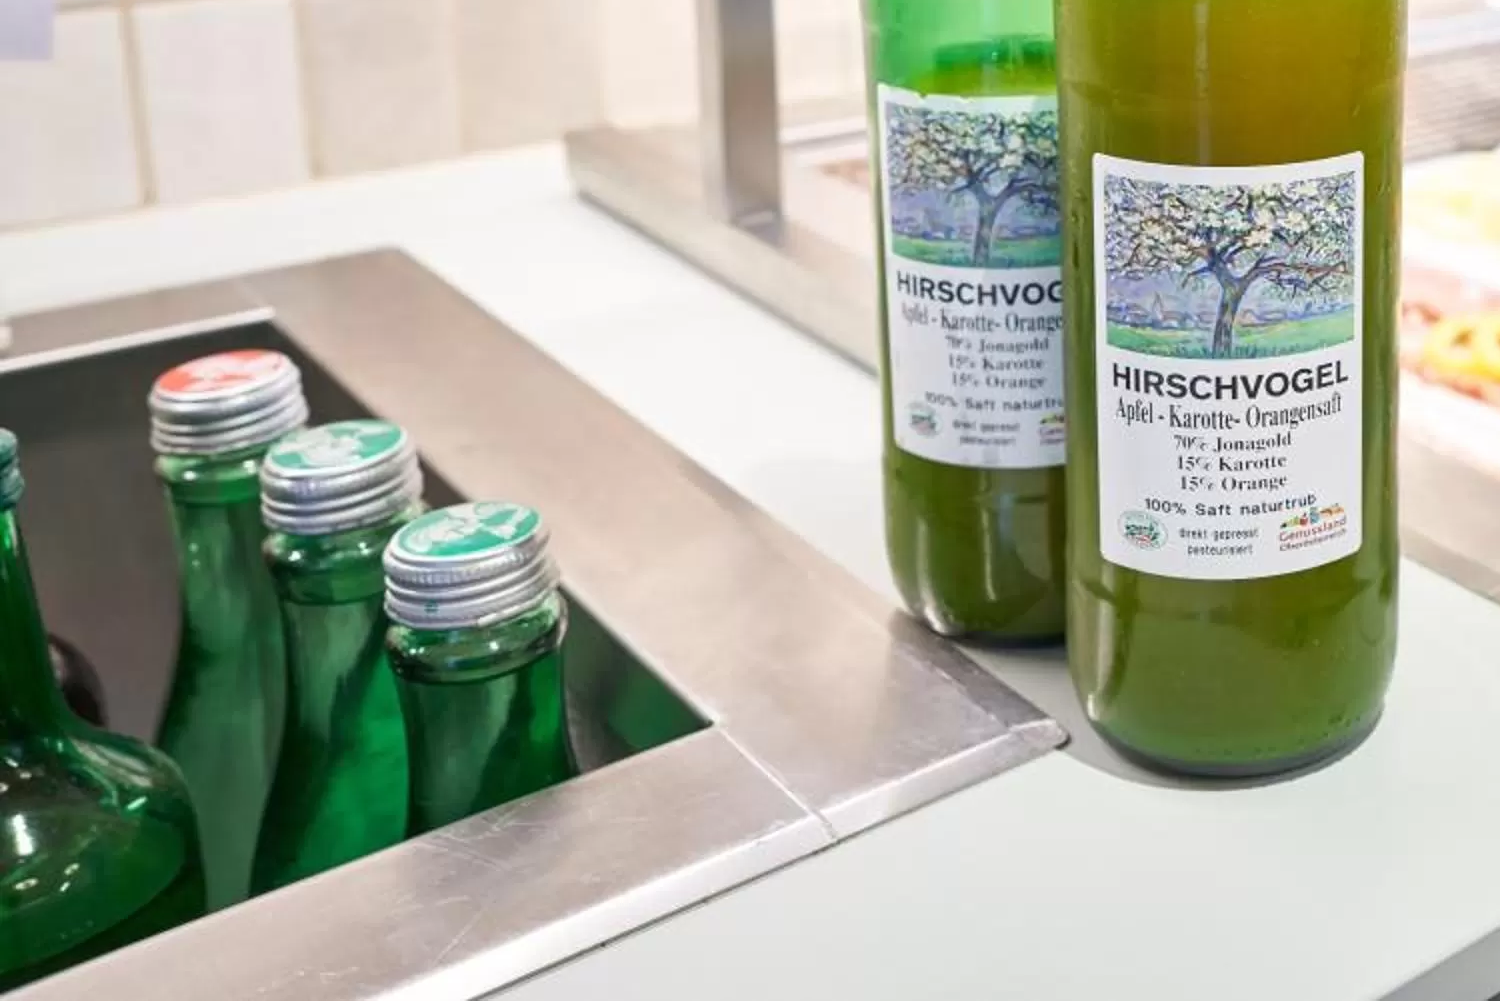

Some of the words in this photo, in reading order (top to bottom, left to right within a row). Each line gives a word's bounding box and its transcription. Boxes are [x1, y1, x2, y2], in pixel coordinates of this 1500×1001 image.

[978, 337, 1049, 354] Jonagold
[982, 357, 1045, 371] Karotte
[985, 376, 1047, 389] Orange
[1112, 360, 1349, 400] HIRSCHVOGEL
[1115, 396, 1154, 427] Apfel
[1246, 391, 1342, 429] Orangensaft
[1174, 434, 1209, 452] 70%
[1213, 431, 1292, 453] Jonagold
[1178, 455, 1212, 471] 15%
[1219, 455, 1288, 471] Karotte
[1181, 476, 1215, 492] 15%
[1221, 475, 1288, 492] Orange
[1144, 498, 1187, 515] 100%
[1195, 503, 1231, 516] Saft
